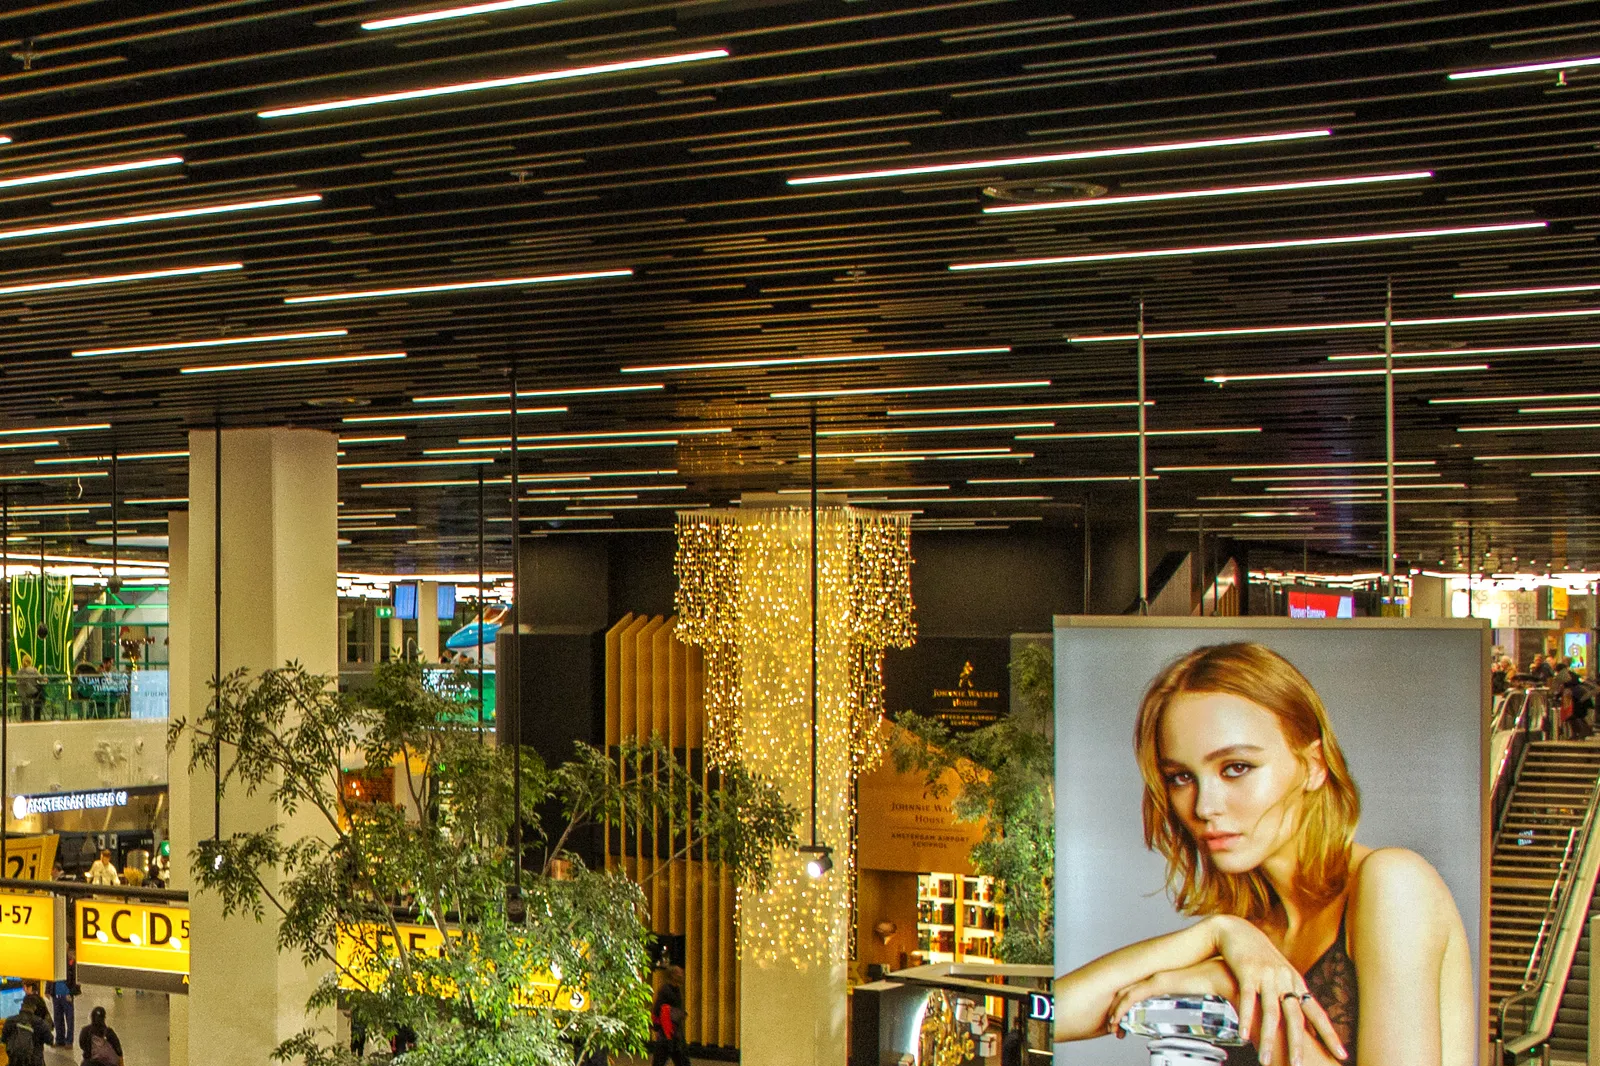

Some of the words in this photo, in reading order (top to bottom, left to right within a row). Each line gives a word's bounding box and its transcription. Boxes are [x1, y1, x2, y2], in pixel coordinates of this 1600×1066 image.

[82, 907, 101, 939] B
[111, 909, 132, 943] C
[149, 912, 173, 945] D
[1030, 993, 1055, 1020] Di
